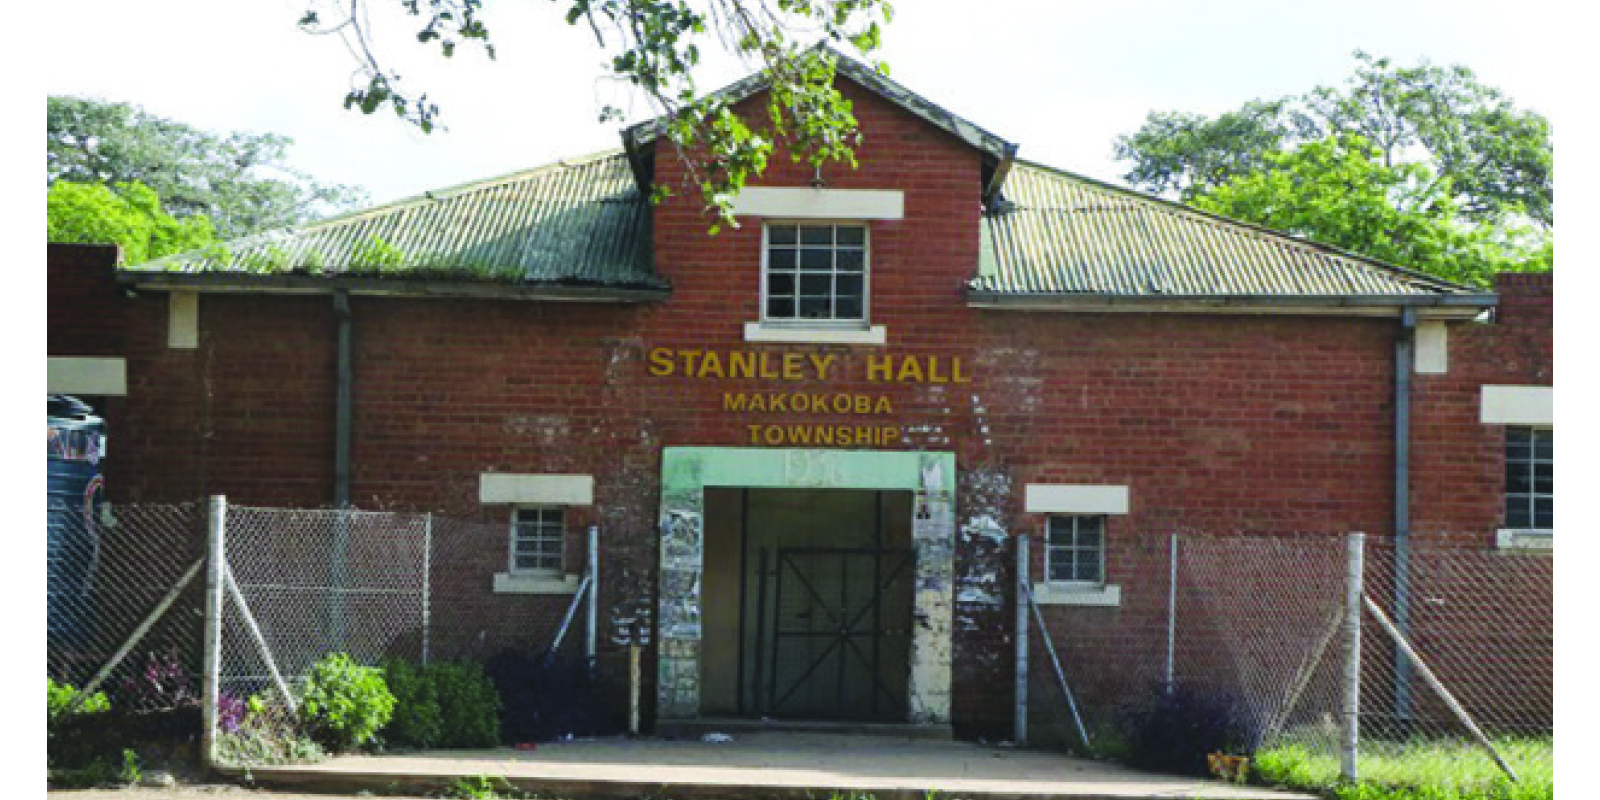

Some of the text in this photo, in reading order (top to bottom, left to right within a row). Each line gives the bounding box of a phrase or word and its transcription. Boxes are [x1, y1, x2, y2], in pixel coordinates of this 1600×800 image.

[650, 347, 972, 382] STANLEY HALL
[723, 393, 892, 414] MAKOKOBA
[747, 424, 900, 445] TOWNSHIP
